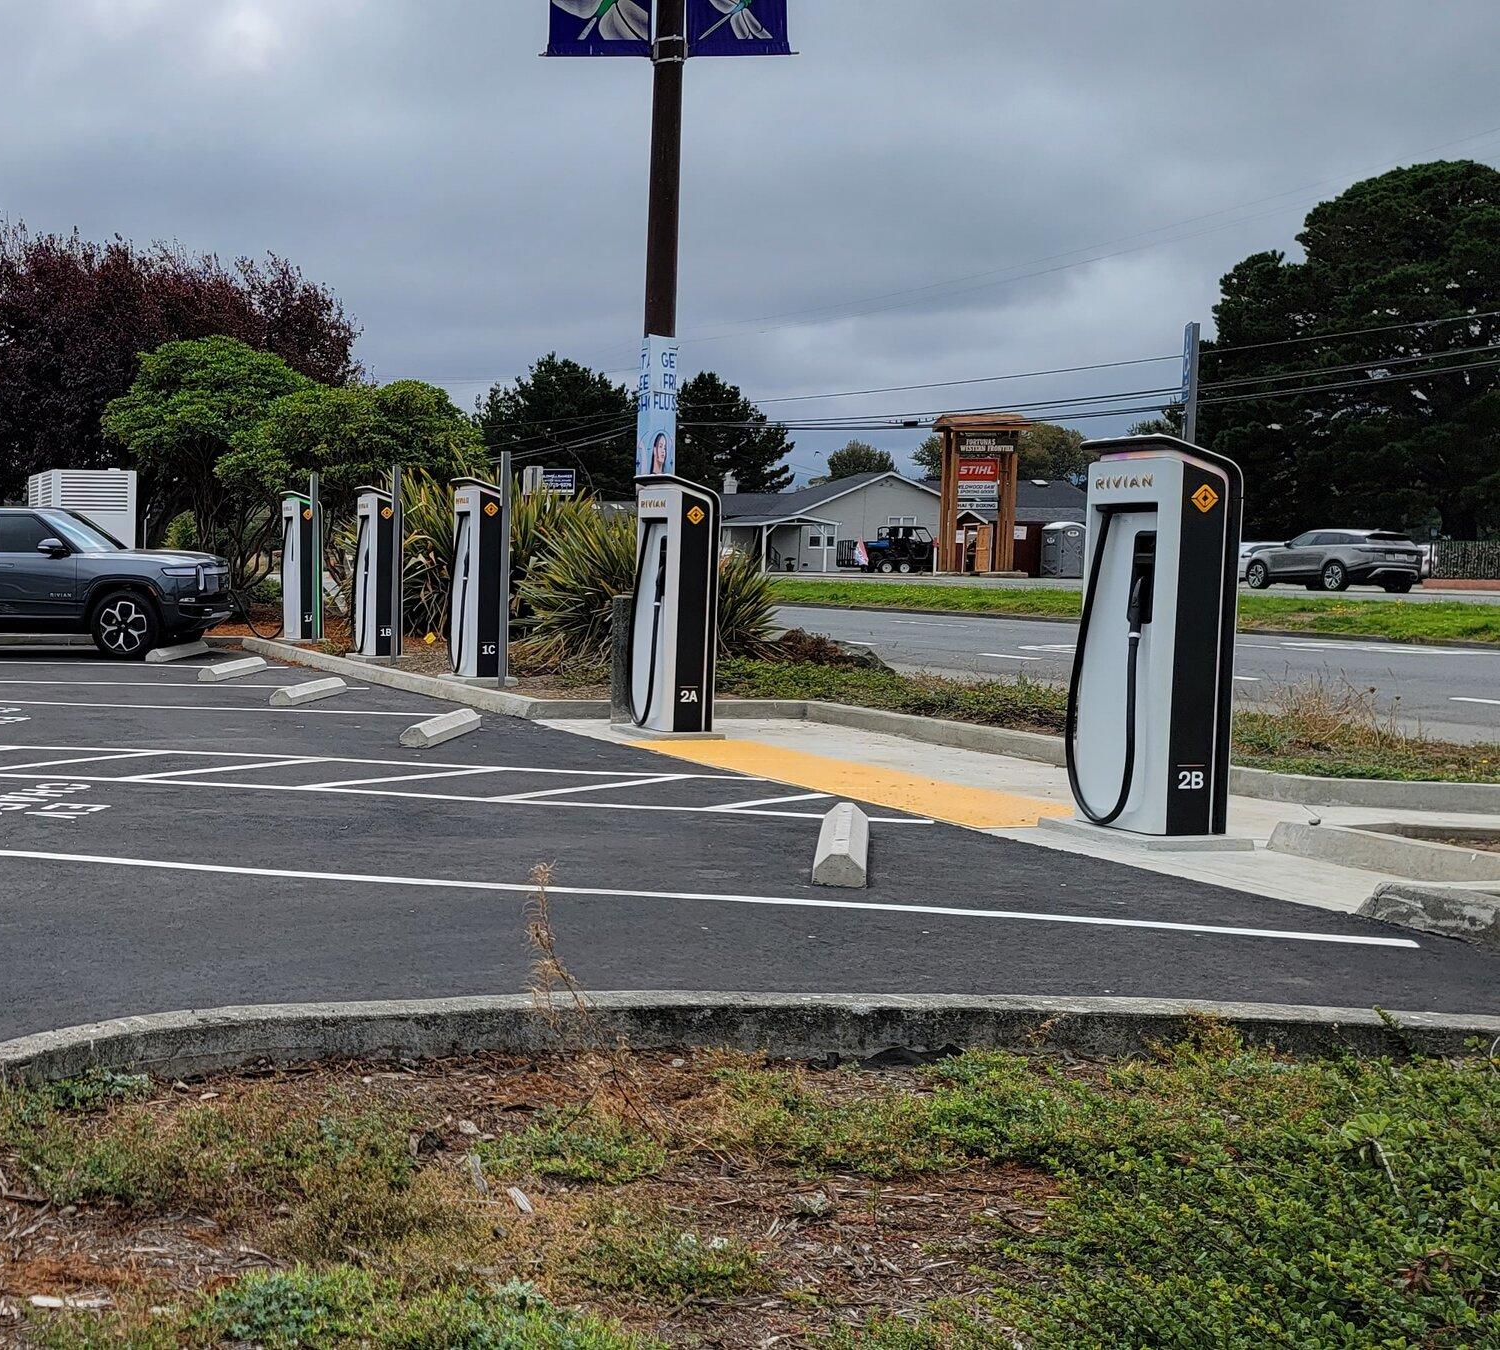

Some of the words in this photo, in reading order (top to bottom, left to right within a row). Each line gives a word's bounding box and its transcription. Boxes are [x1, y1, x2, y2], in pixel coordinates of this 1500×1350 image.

[959, 466, 995, 475] STIHL
[1095, 474, 1154, 490] RIVIAN
[640, 500, 666, 508] RIVIAN
[380, 628, 392, 637] 1B
[482, 645, 496, 654] 1C
[680, 690, 698, 702] 2A
[1178, 771, 1204, 789] 2B
[24, 802, 112, 820] EV
